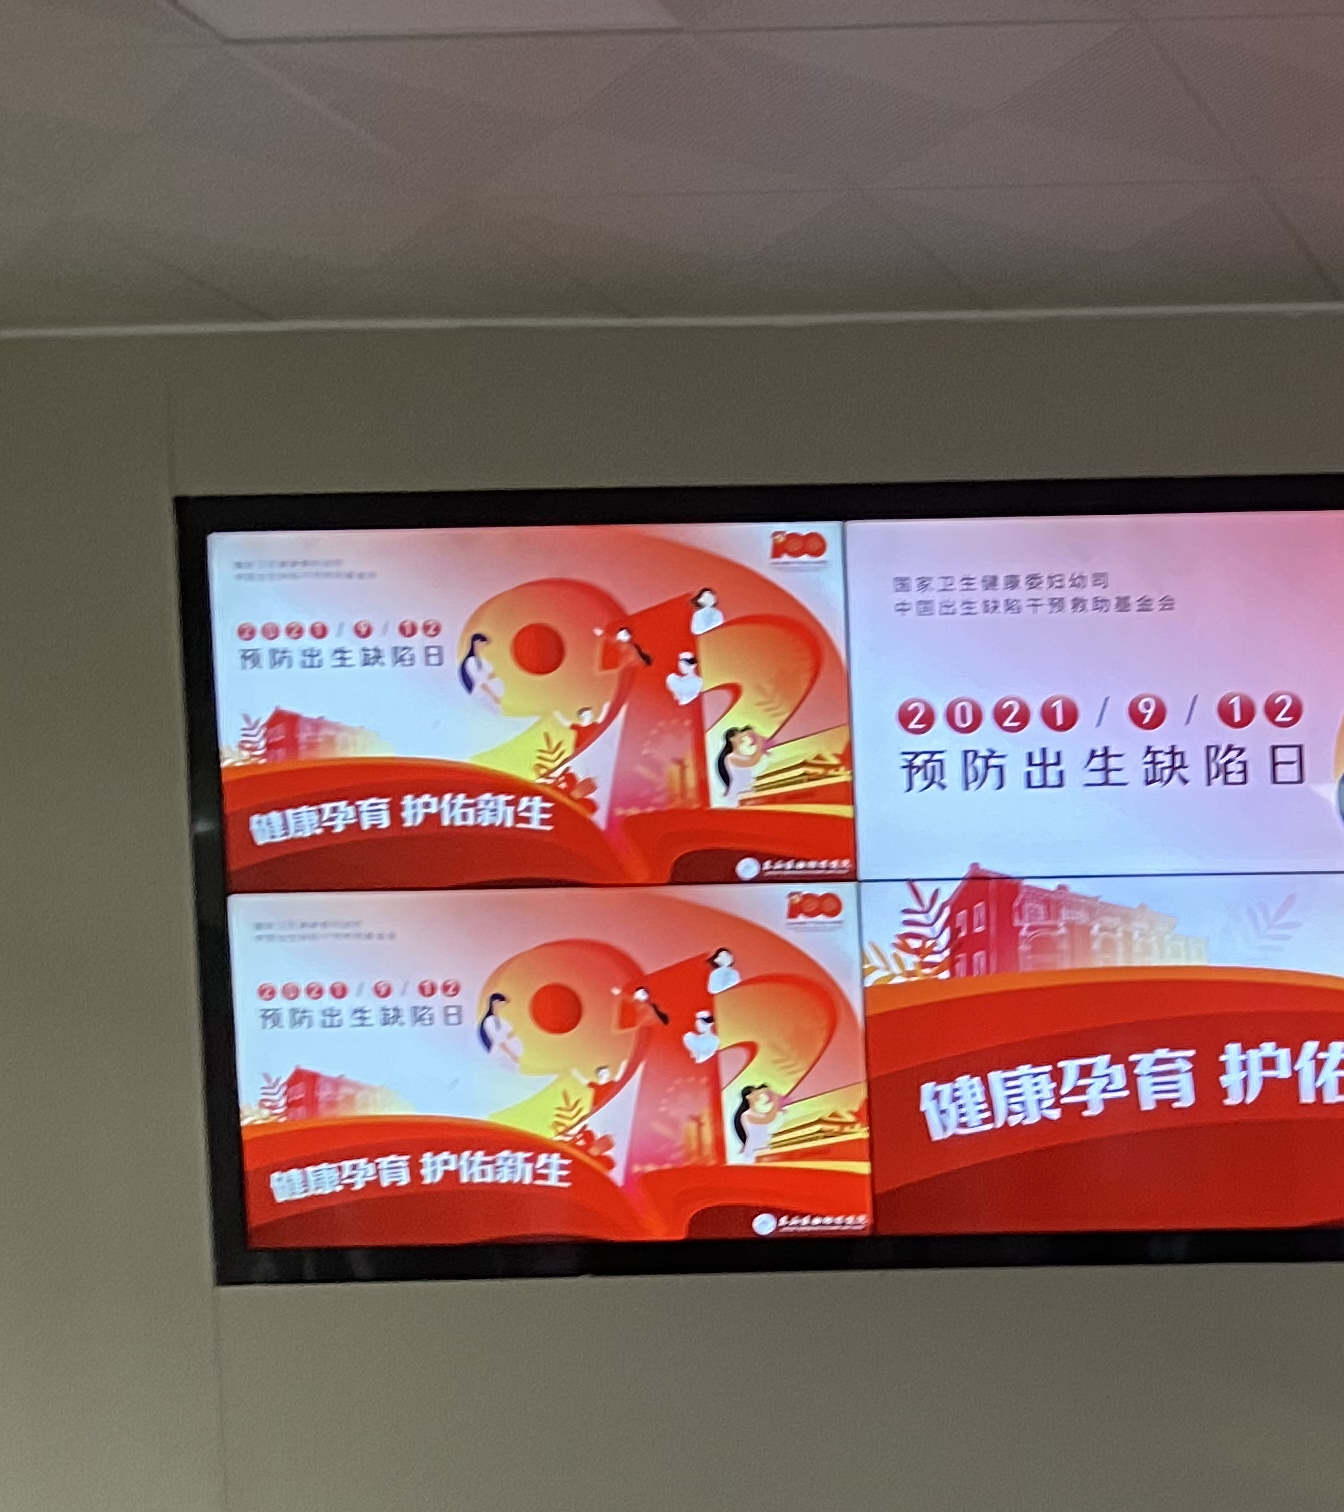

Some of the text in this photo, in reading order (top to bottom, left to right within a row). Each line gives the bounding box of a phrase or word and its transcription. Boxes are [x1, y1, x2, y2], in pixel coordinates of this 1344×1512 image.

[893, 571, 1110, 594] 国家卫生健康委妇幼司
[239, 645, 445, 670] 预防出生缺陷日
[900, 743, 1307, 793] 预防出生缺陷日
[250, 792, 555, 846] 健康孕育 护佑新生
[258, 1005, 464, 1030] 预防出生缺陷日
[919, 1046, 1197, 1142] 健康孕育
[270, 1150, 573, 1203] 健康孕育 护佑新生
